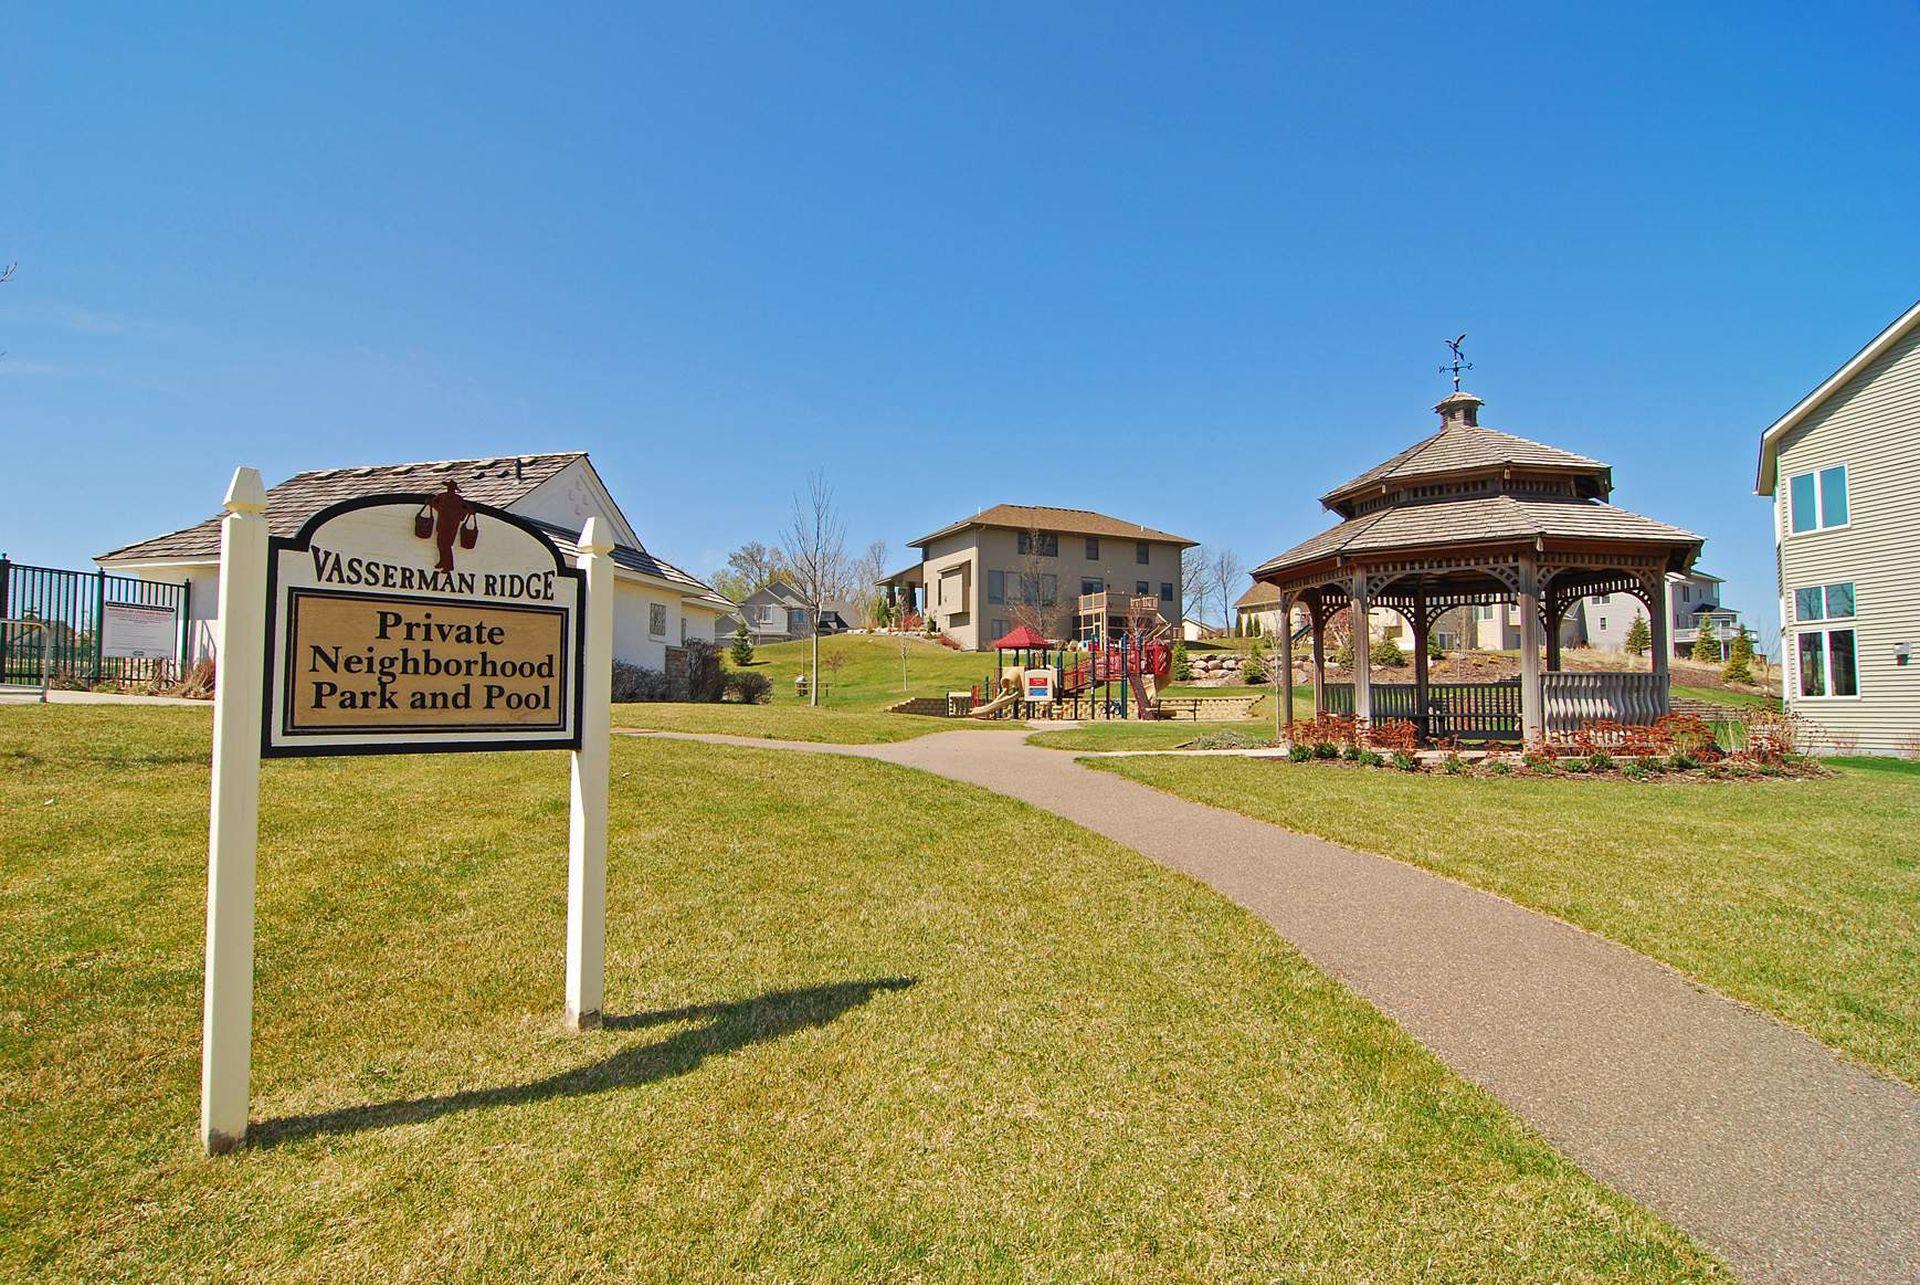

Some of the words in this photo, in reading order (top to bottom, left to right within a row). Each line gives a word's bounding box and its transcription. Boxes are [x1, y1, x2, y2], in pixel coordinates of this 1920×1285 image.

[310, 545, 475, 594] VASSERMAN
[484, 570, 556, 601] RIDGE
[375, 610, 505, 645] Private
[308, 645, 555, 684] Neighborhood
[310, 681, 399, 710] Park
[409, 684, 472, 710] and
[483, 685, 552, 710] Pool
